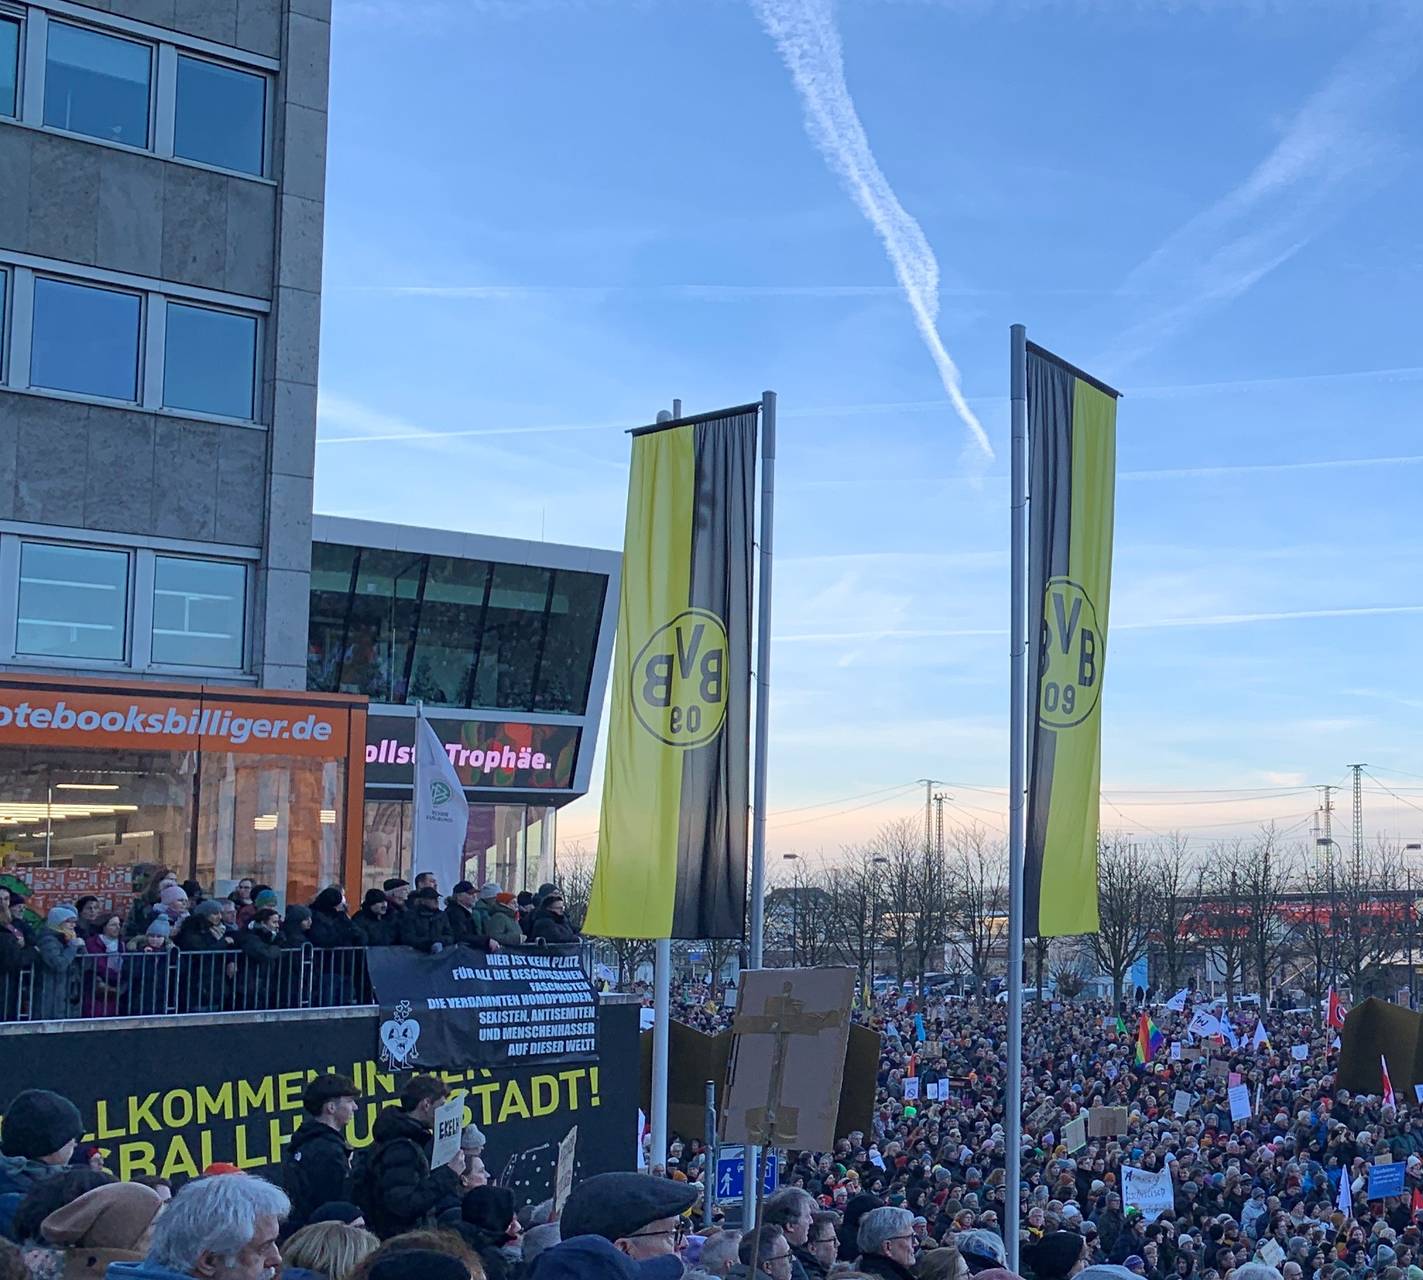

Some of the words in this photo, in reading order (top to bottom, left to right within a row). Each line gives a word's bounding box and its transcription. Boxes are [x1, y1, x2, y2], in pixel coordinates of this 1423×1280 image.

[1044, 682, 1075, 715] 09
[445, 743, 551, 773] Trophäe.
[486, 954, 510, 966] HIER
[511, 954, 527, 966] IST
[527, 955, 550, 968] KEIN
[551, 955, 580, 969] PLATZ
[452, 966, 475, 980] FÜR
[475, 969, 493, 981] ALL
[493, 969, 511, 980] DIE
[529, 982, 591, 992] FASCHISTEN
[427, 998, 449, 1009] DIE
[448, 995, 521, 1009] VERDAMMTEN
[479, 1011, 530, 1025] SEXISTEN,
[531, 1006, 595, 1022] ANTISEMITEN
[479, 1028, 501, 1041] UND
[502, 1022, 595, 1040] MENSCHENHASSER
[507, 1043, 528, 1057] AUF
[529, 1040, 564, 1055] DIESER
[565, 1038, 595, 1052] WELT!
